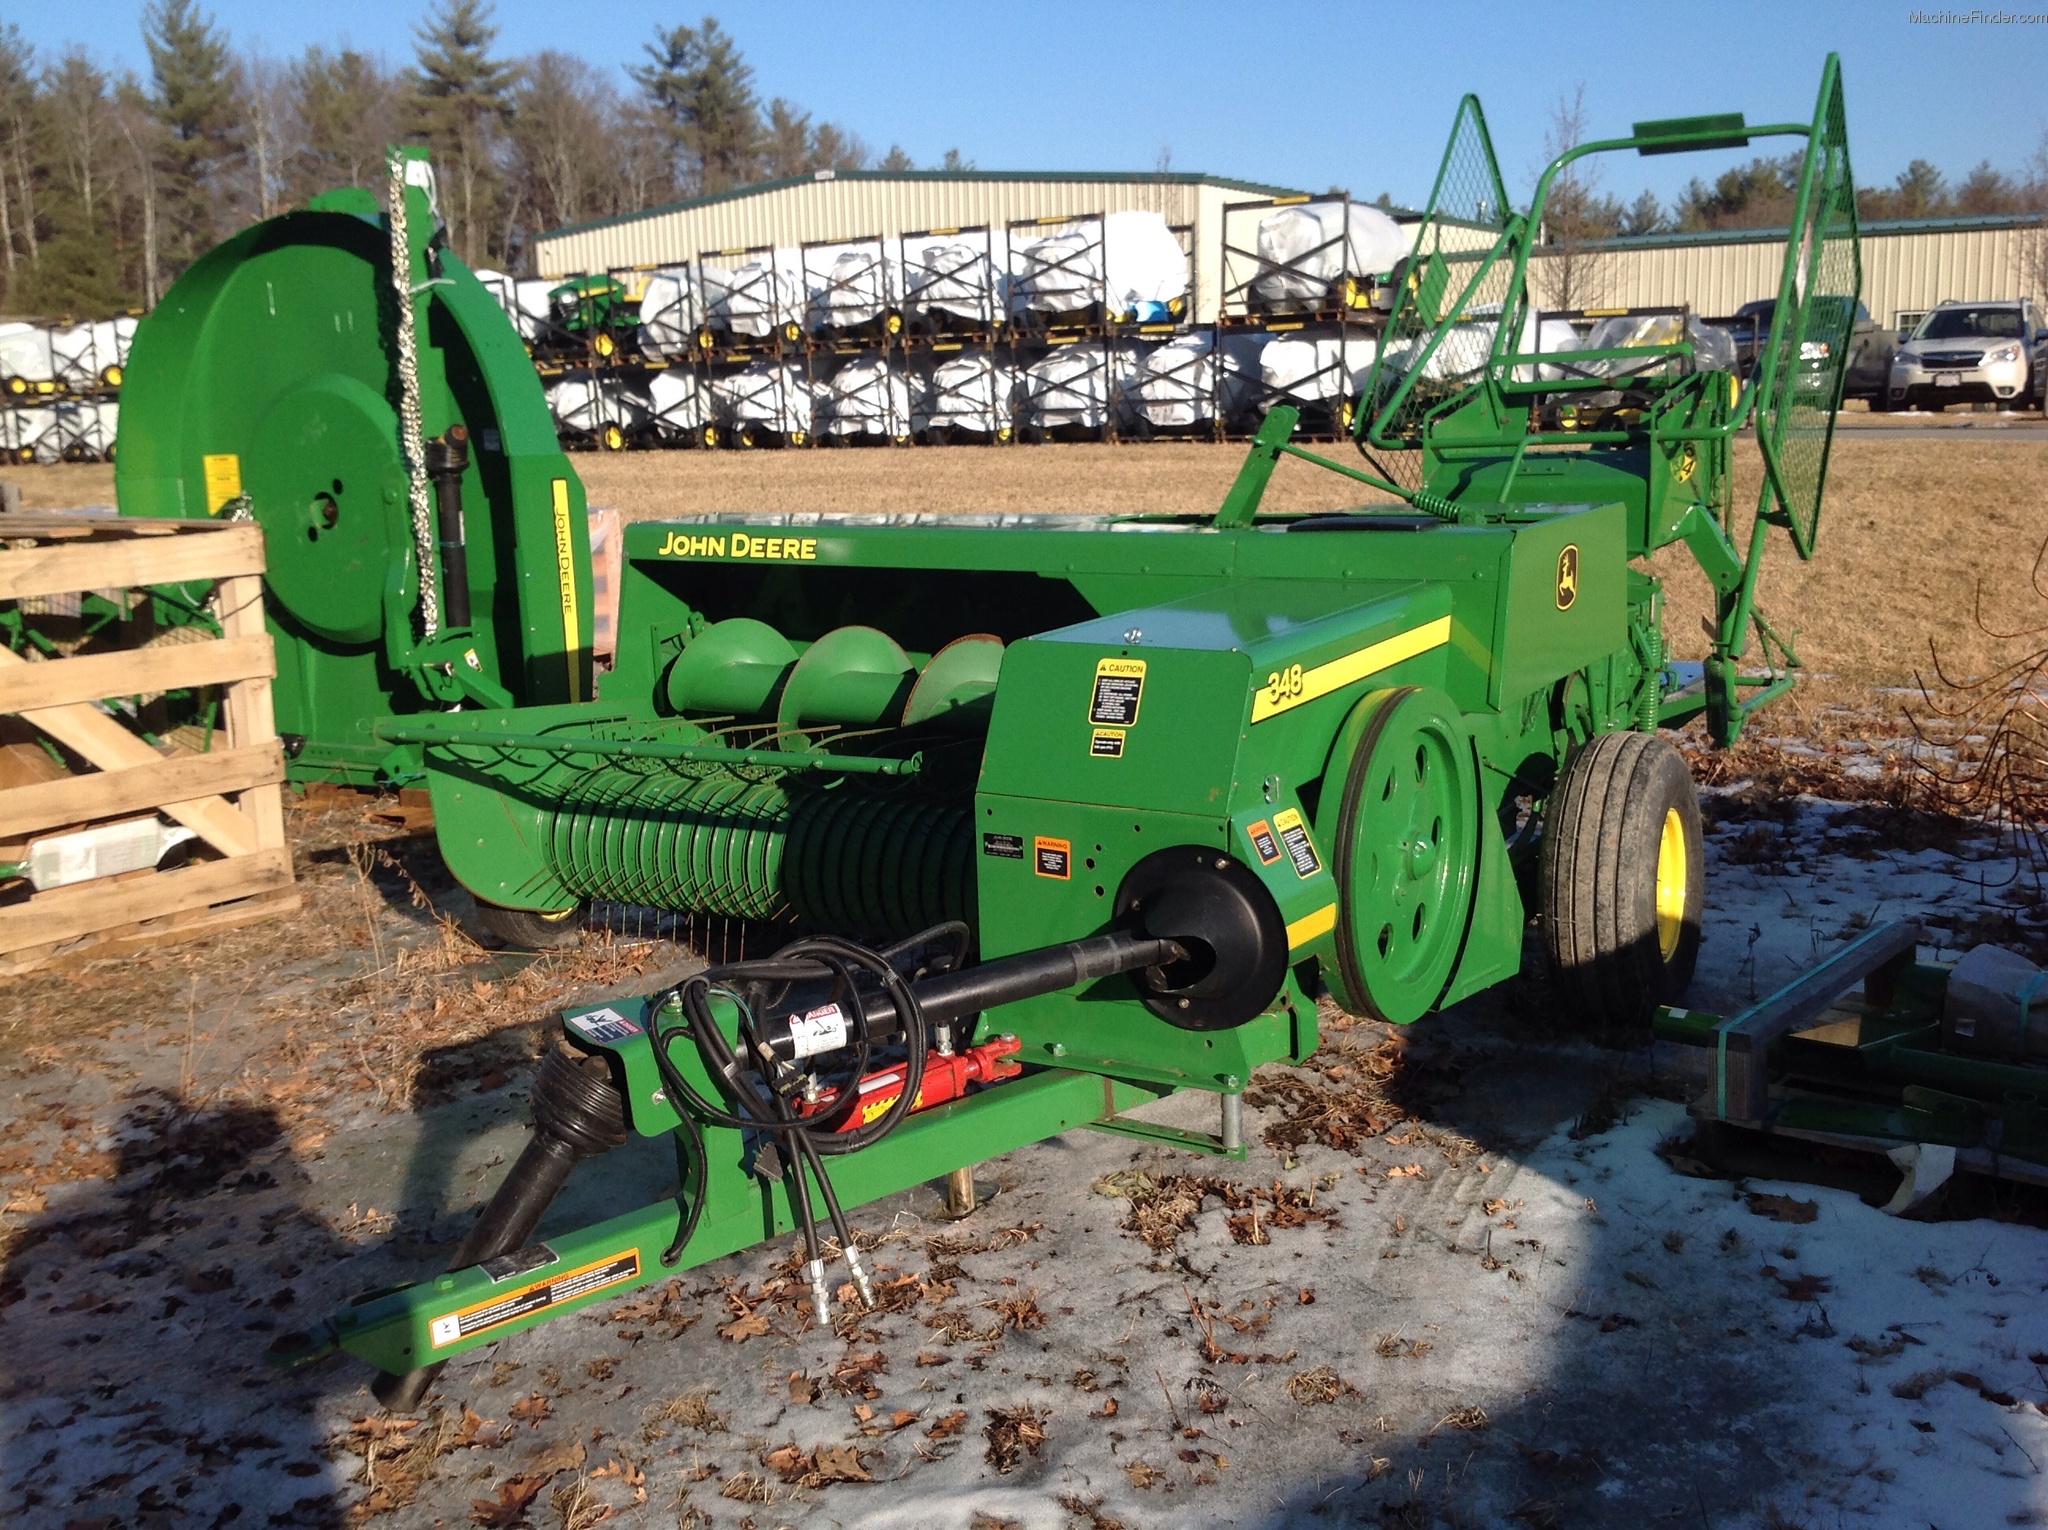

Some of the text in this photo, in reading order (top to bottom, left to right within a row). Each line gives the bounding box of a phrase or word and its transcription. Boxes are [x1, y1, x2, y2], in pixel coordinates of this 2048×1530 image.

[658, 531, 818, 560] JOHN DEERE
[555, 507, 572, 614] JOHN DEERE
[1109, 664, 1144, 673] CAUTION
[1267, 663, 1302, 704] 348
[1042, 840, 1067, 849] WARNING
[808, 1006, 836, 1020] ANGER
[534, 1273, 569, 1290] WARNING
